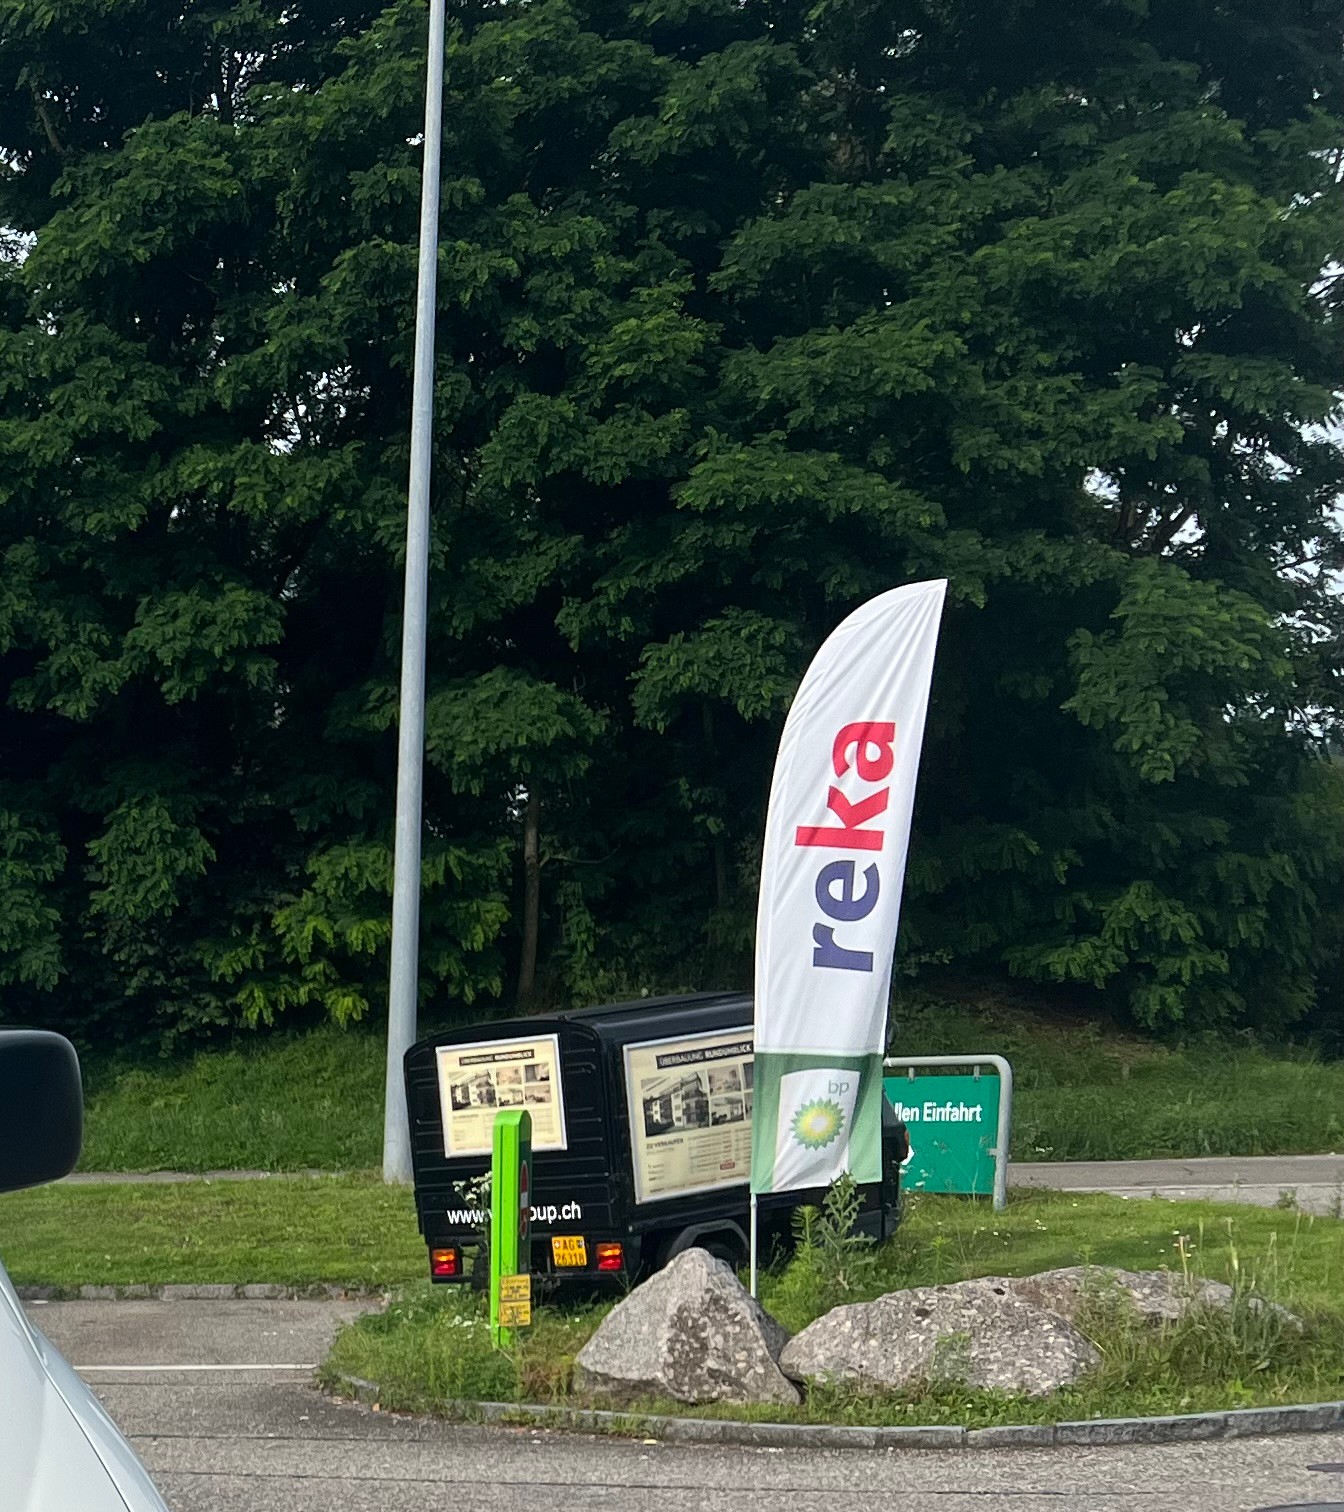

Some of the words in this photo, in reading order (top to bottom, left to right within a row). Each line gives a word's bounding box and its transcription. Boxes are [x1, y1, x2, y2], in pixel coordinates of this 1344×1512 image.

[795, 721, 896, 972] reka
[828, 1080, 850, 1096] bp
[923, 1101, 983, 1122] Einfahrt
[562, 1239, 576, 1251] AG
